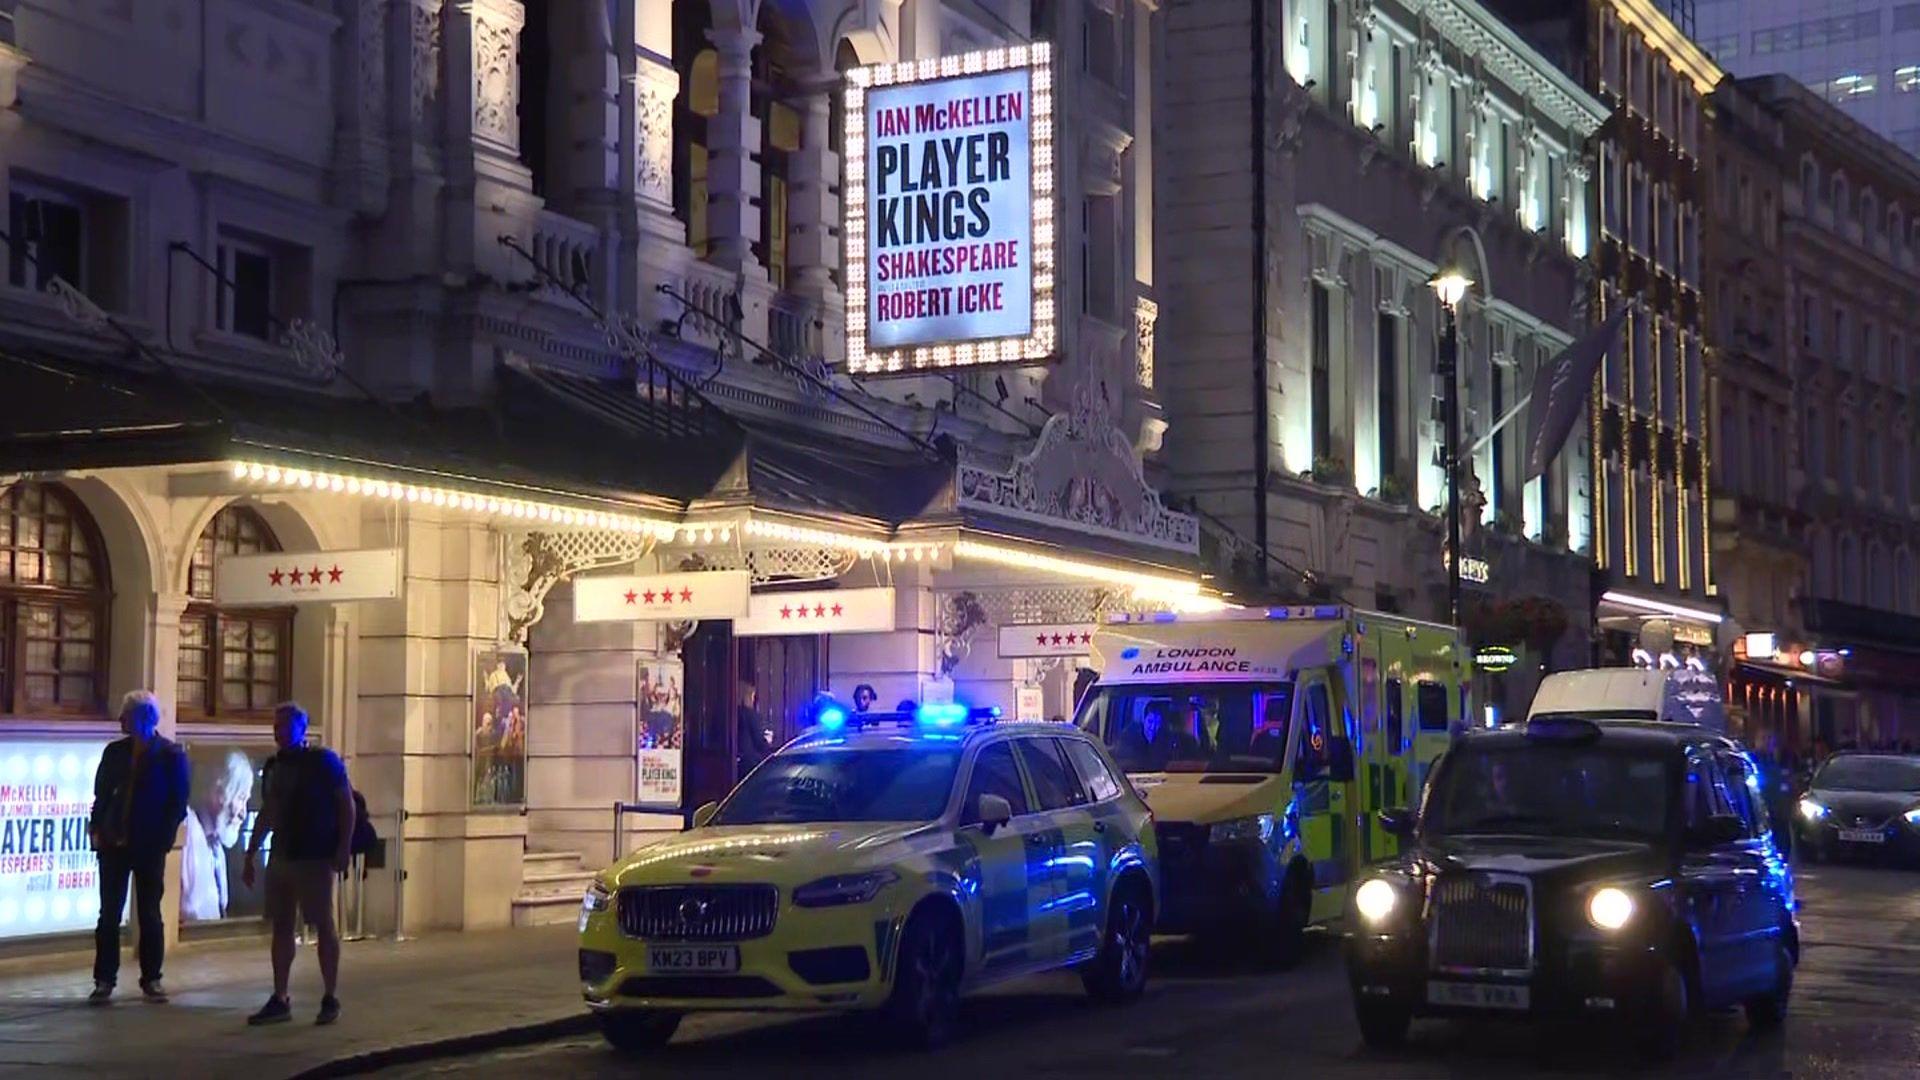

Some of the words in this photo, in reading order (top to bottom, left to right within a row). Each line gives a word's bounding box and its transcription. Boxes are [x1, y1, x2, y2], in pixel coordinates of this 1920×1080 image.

[876, 105, 910, 138] IAN
[915, 91, 1023, 134] McKELLEN
[876, 131, 1011, 195] PLAYER
[877, 187, 991, 248] KINGS
[877, 240, 1019, 282] SHAKESPEARE
[877, 287, 953, 322] ROBERT
[957, 282, 1004, 315] ICKE
[1132, 660, 1251, 676] AMBULANCE
[1156, 647, 1237, 659] LONDON
